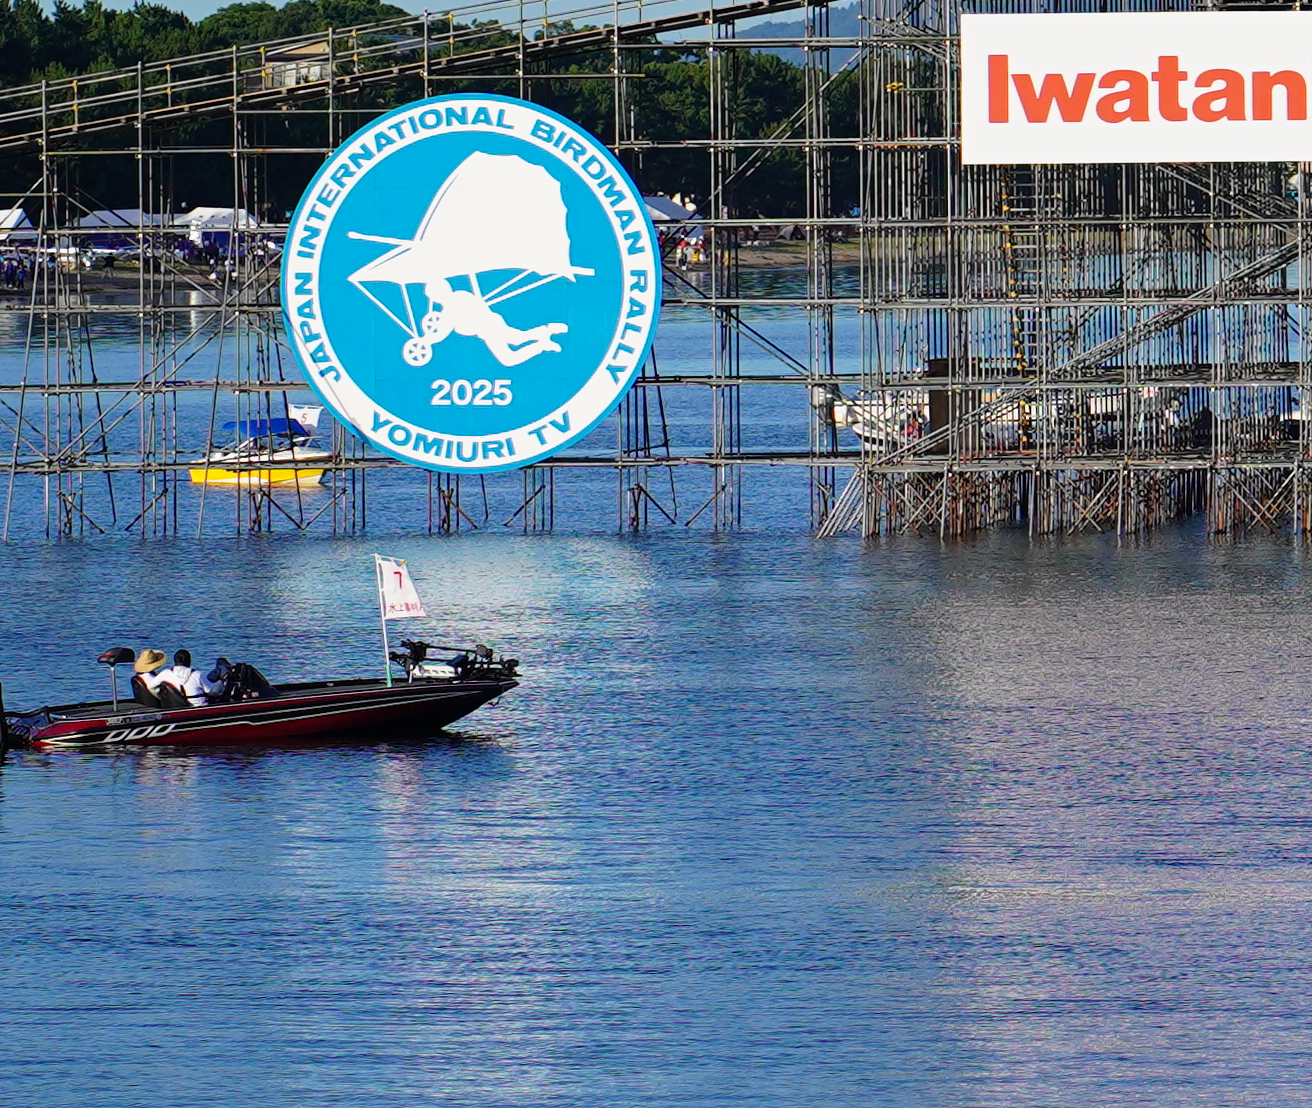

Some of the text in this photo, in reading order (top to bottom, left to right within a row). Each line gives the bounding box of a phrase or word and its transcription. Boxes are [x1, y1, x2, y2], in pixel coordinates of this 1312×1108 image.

[295, 106, 648, 384] JAPAN INTERNATIONAL BIRDMAN RALLY
[431, 379, 513, 406] 2025
[301, 413, 308, 424] 5
[370, 411, 572, 463] YOMIURI TV
[393, 571, 403, 589] 7
